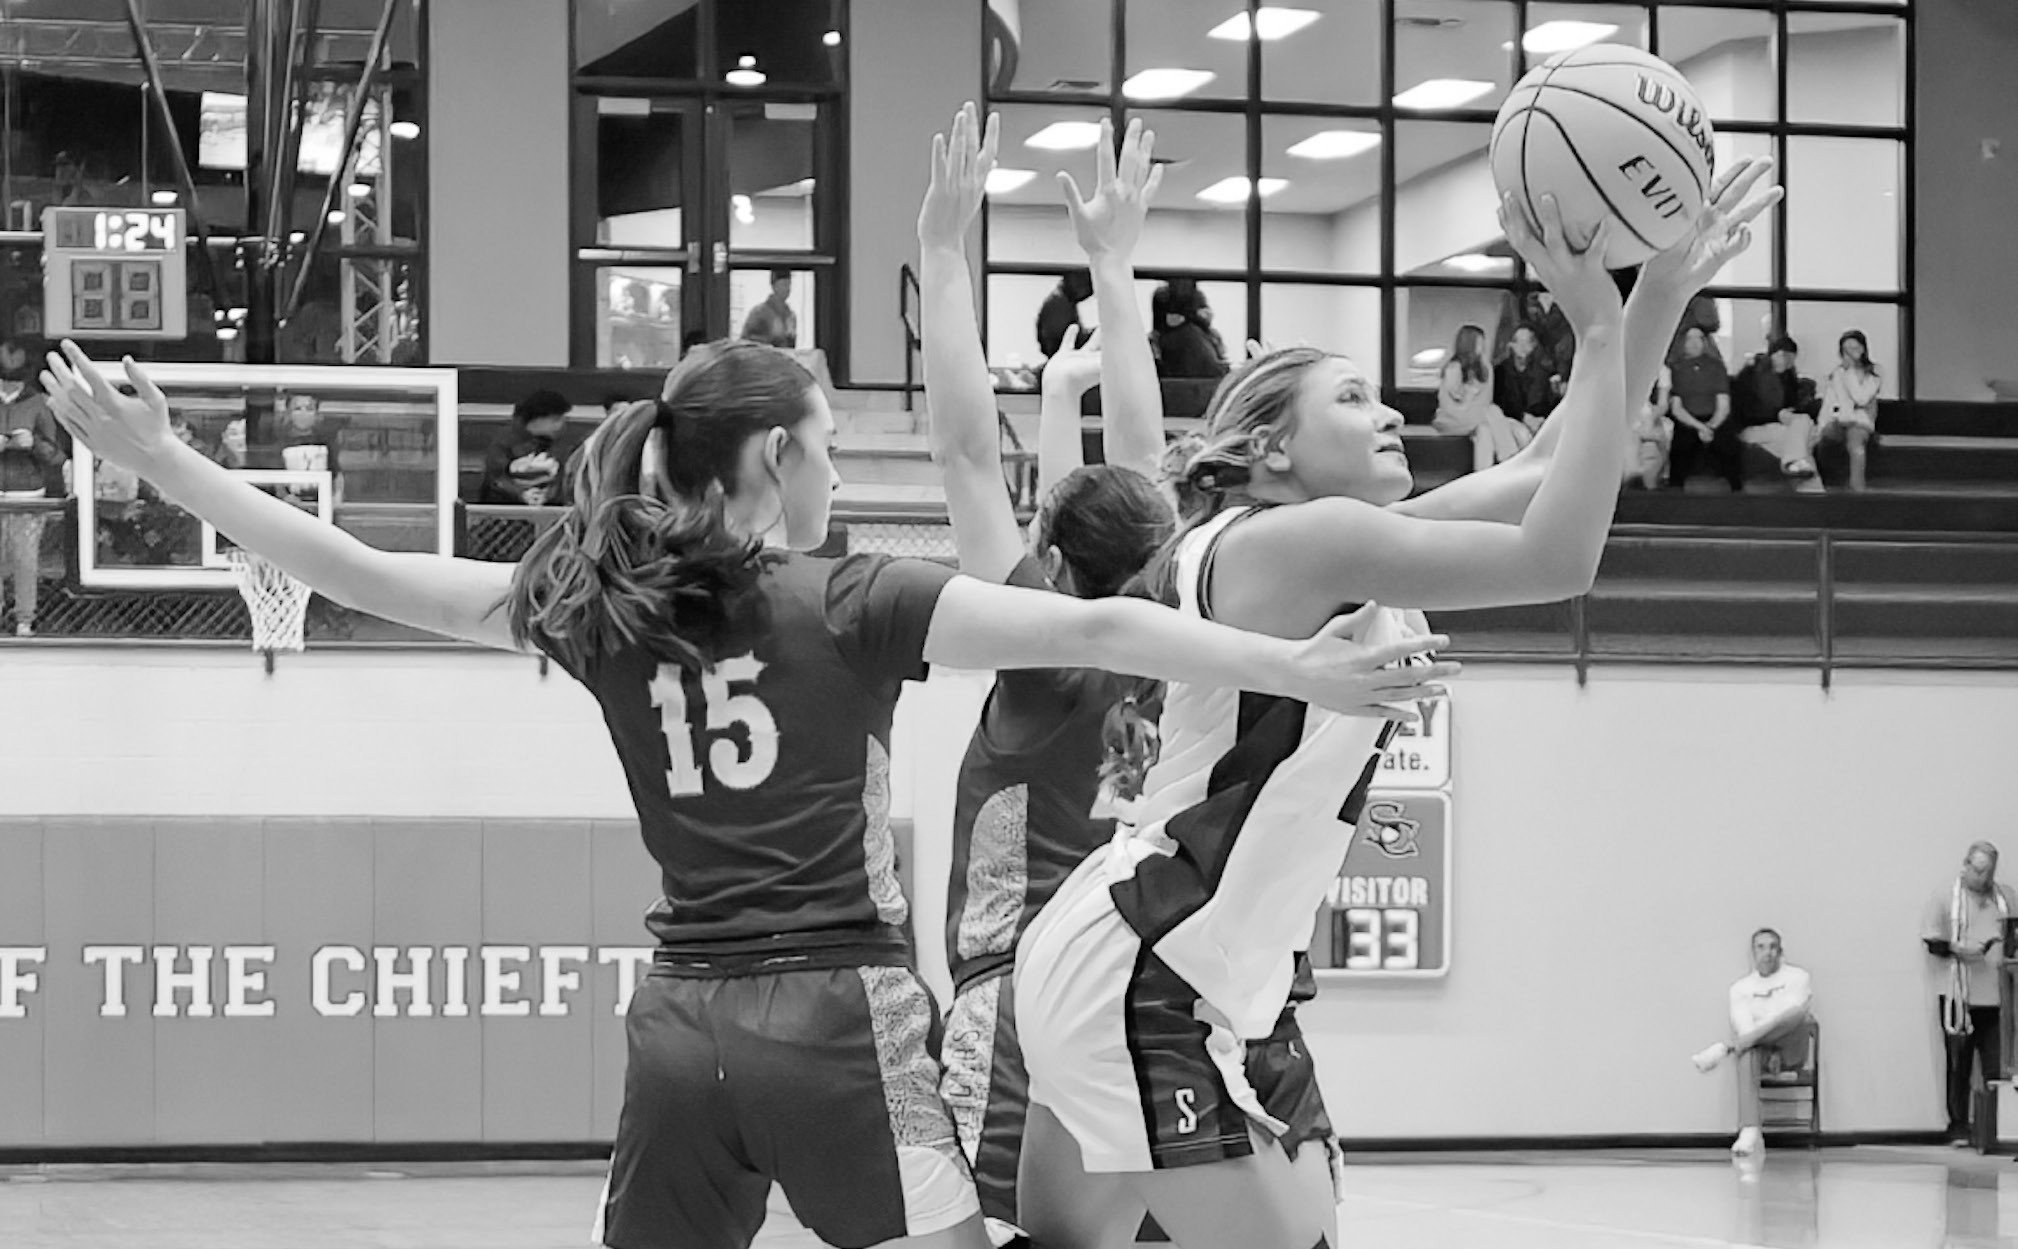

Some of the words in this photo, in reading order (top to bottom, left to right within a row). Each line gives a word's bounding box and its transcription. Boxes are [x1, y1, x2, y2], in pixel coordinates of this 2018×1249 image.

[94, 212, 175, 252] 1:24
[648, 650, 781, 798] 15
[1326, 876, 1428, 905] VISITOR
[1346, 908, 1419, 969] 33
[83, 945, 275, 1016] THE
[312, 945, 655, 1017] CHIEFT
[1175, 1087, 1198, 1134] S
